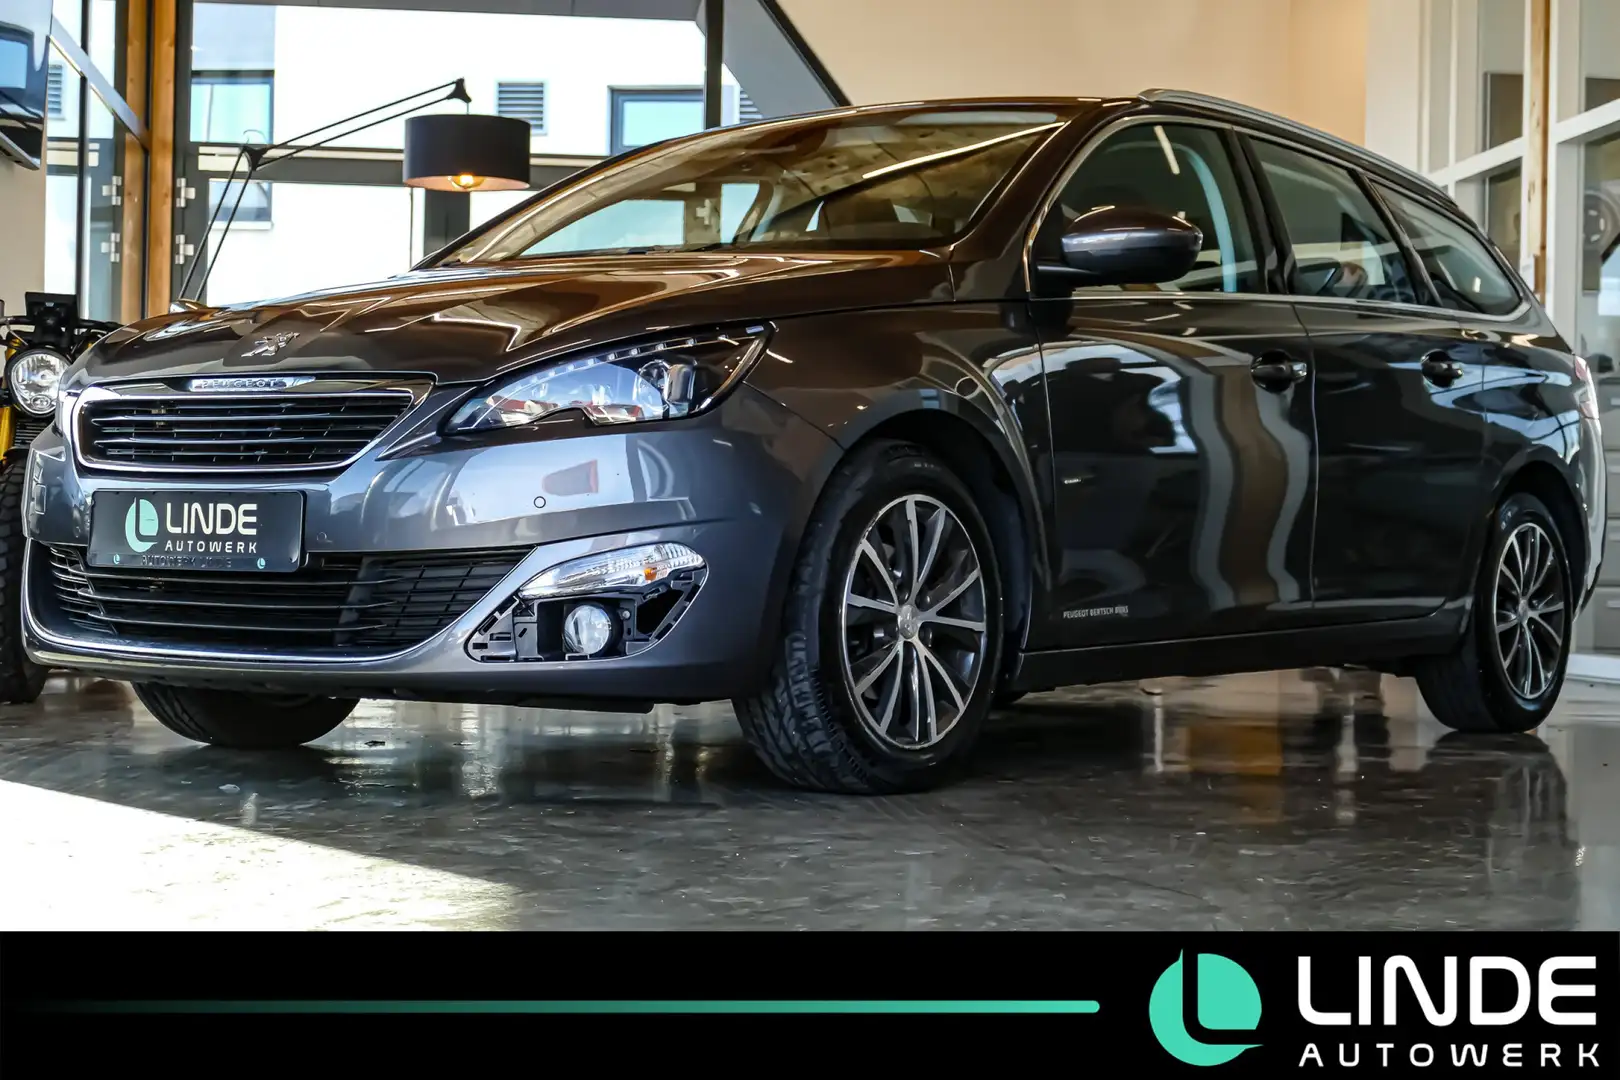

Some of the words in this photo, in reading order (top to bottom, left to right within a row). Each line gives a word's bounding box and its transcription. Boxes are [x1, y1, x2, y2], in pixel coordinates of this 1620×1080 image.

[201, 379, 278, 389] PEUGEOT
[166, 502, 258, 536] LINDE
[164, 540, 257, 554] AUTOWERK
